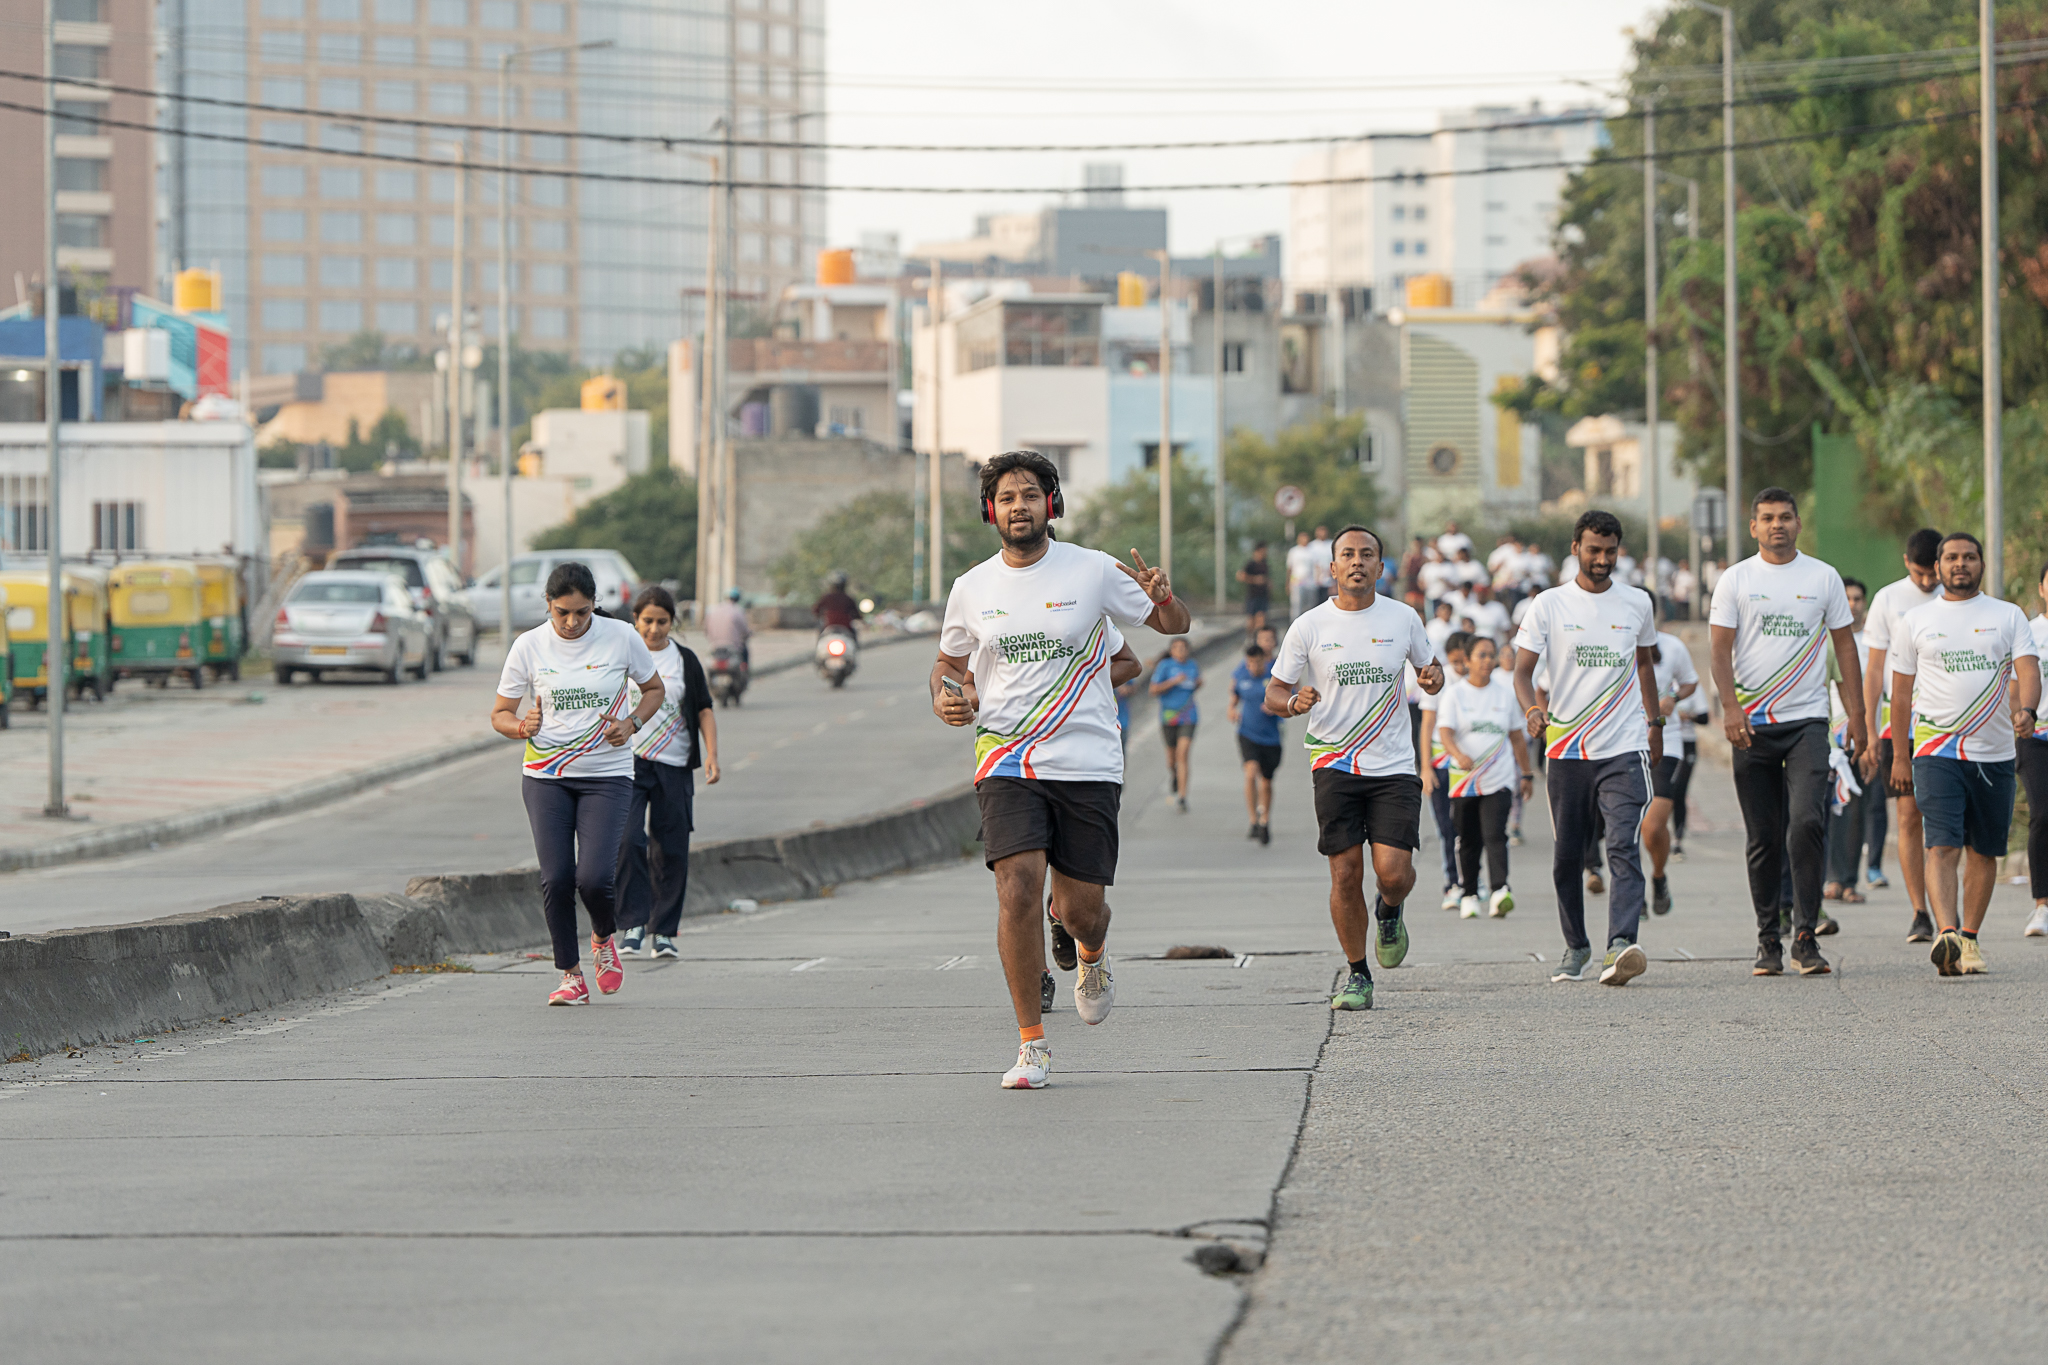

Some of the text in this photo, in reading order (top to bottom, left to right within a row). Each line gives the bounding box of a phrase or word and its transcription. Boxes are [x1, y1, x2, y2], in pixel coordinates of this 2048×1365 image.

[1762, 628, 1810, 636] WELLNESS
[1002, 638, 1062, 652] TOWARDS
[1006, 646, 1074, 664] WELLNESS
[1943, 654, 1986, 664] TOWARDS
[1578, 658, 1626, 667] WELLNESS
[1944, 660, 1998, 673] WELLNESS
[1336, 666, 1384, 678] TOWARDS
[1338, 674, 1393, 686] WELLNESS
[552, 692, 598, 702] TOWARDS
[553, 697, 610, 710] WELLNESS
